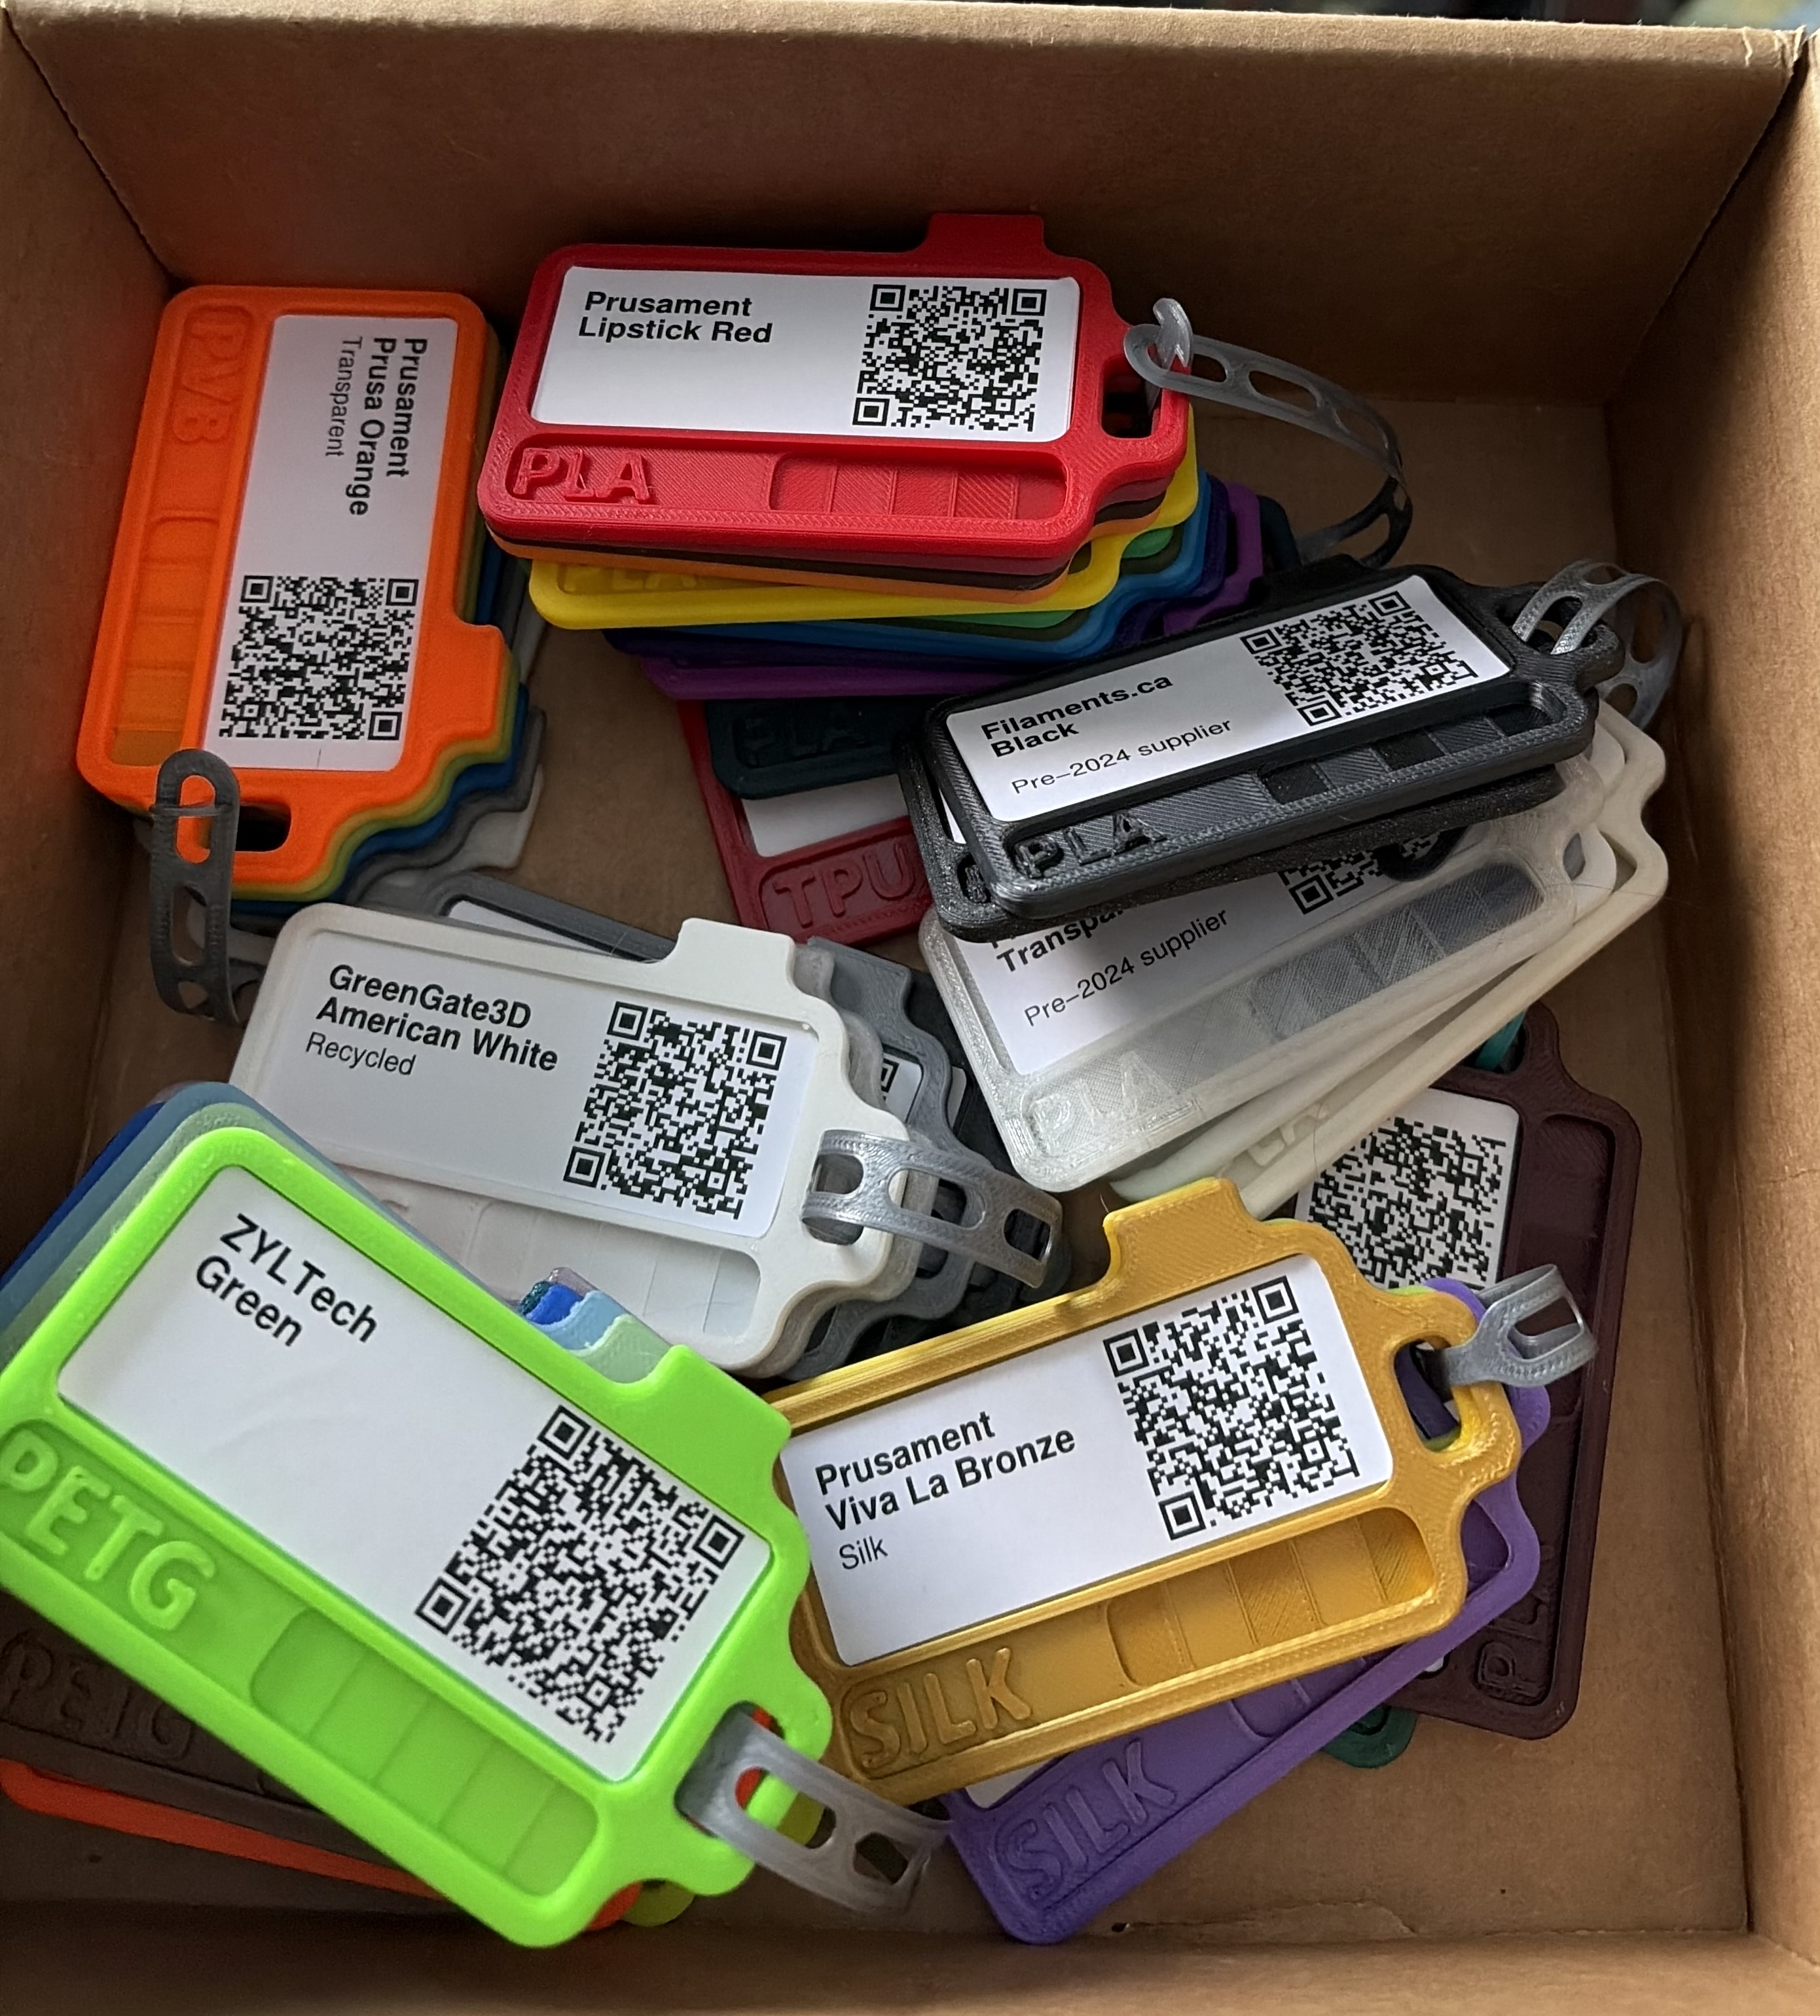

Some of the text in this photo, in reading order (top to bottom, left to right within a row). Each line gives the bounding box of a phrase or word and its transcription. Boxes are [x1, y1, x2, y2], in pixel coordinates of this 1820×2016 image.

[579, 317, 773, 343] Lipstick Red
[585, 291, 752, 316] Prusament
[170, 318, 245, 443] PVB
[325, 336, 363, 456] Transparent
[386, 338, 428, 477] Prusament
[346, 338, 397, 515] Prusa Orange
[513, 447, 652, 503] PLA
[981, 677, 1173, 740] Filaments.ca
[991, 723, 1079, 757] Black
[1138, 721, 1230, 756] supplier
[1017, 809, 1168, 878] PLA
[773, 844, 915, 928] TPU
[1140, 910, 1227, 966] supplier
[316, 996, 557, 1071] American White
[330, 965, 531, 1028] GreenGate3D
[306, 1032, 416, 1075] Recycled
[196, 1255, 302, 1346] Green
[220, 1213, 376, 1342] ZYLTech
[815, 1411, 995, 1496] Prusament
[825, 1430, 1075, 1530] Viva La Bronze
[0, 1429, 215, 1630] PETG
[839, 1536, 888, 1570] Silk
[1478, 1544, 1554, 1700] PL
[850, 1647, 1032, 1768] SILK
[1006, 1738, 1177, 1900] SILK
